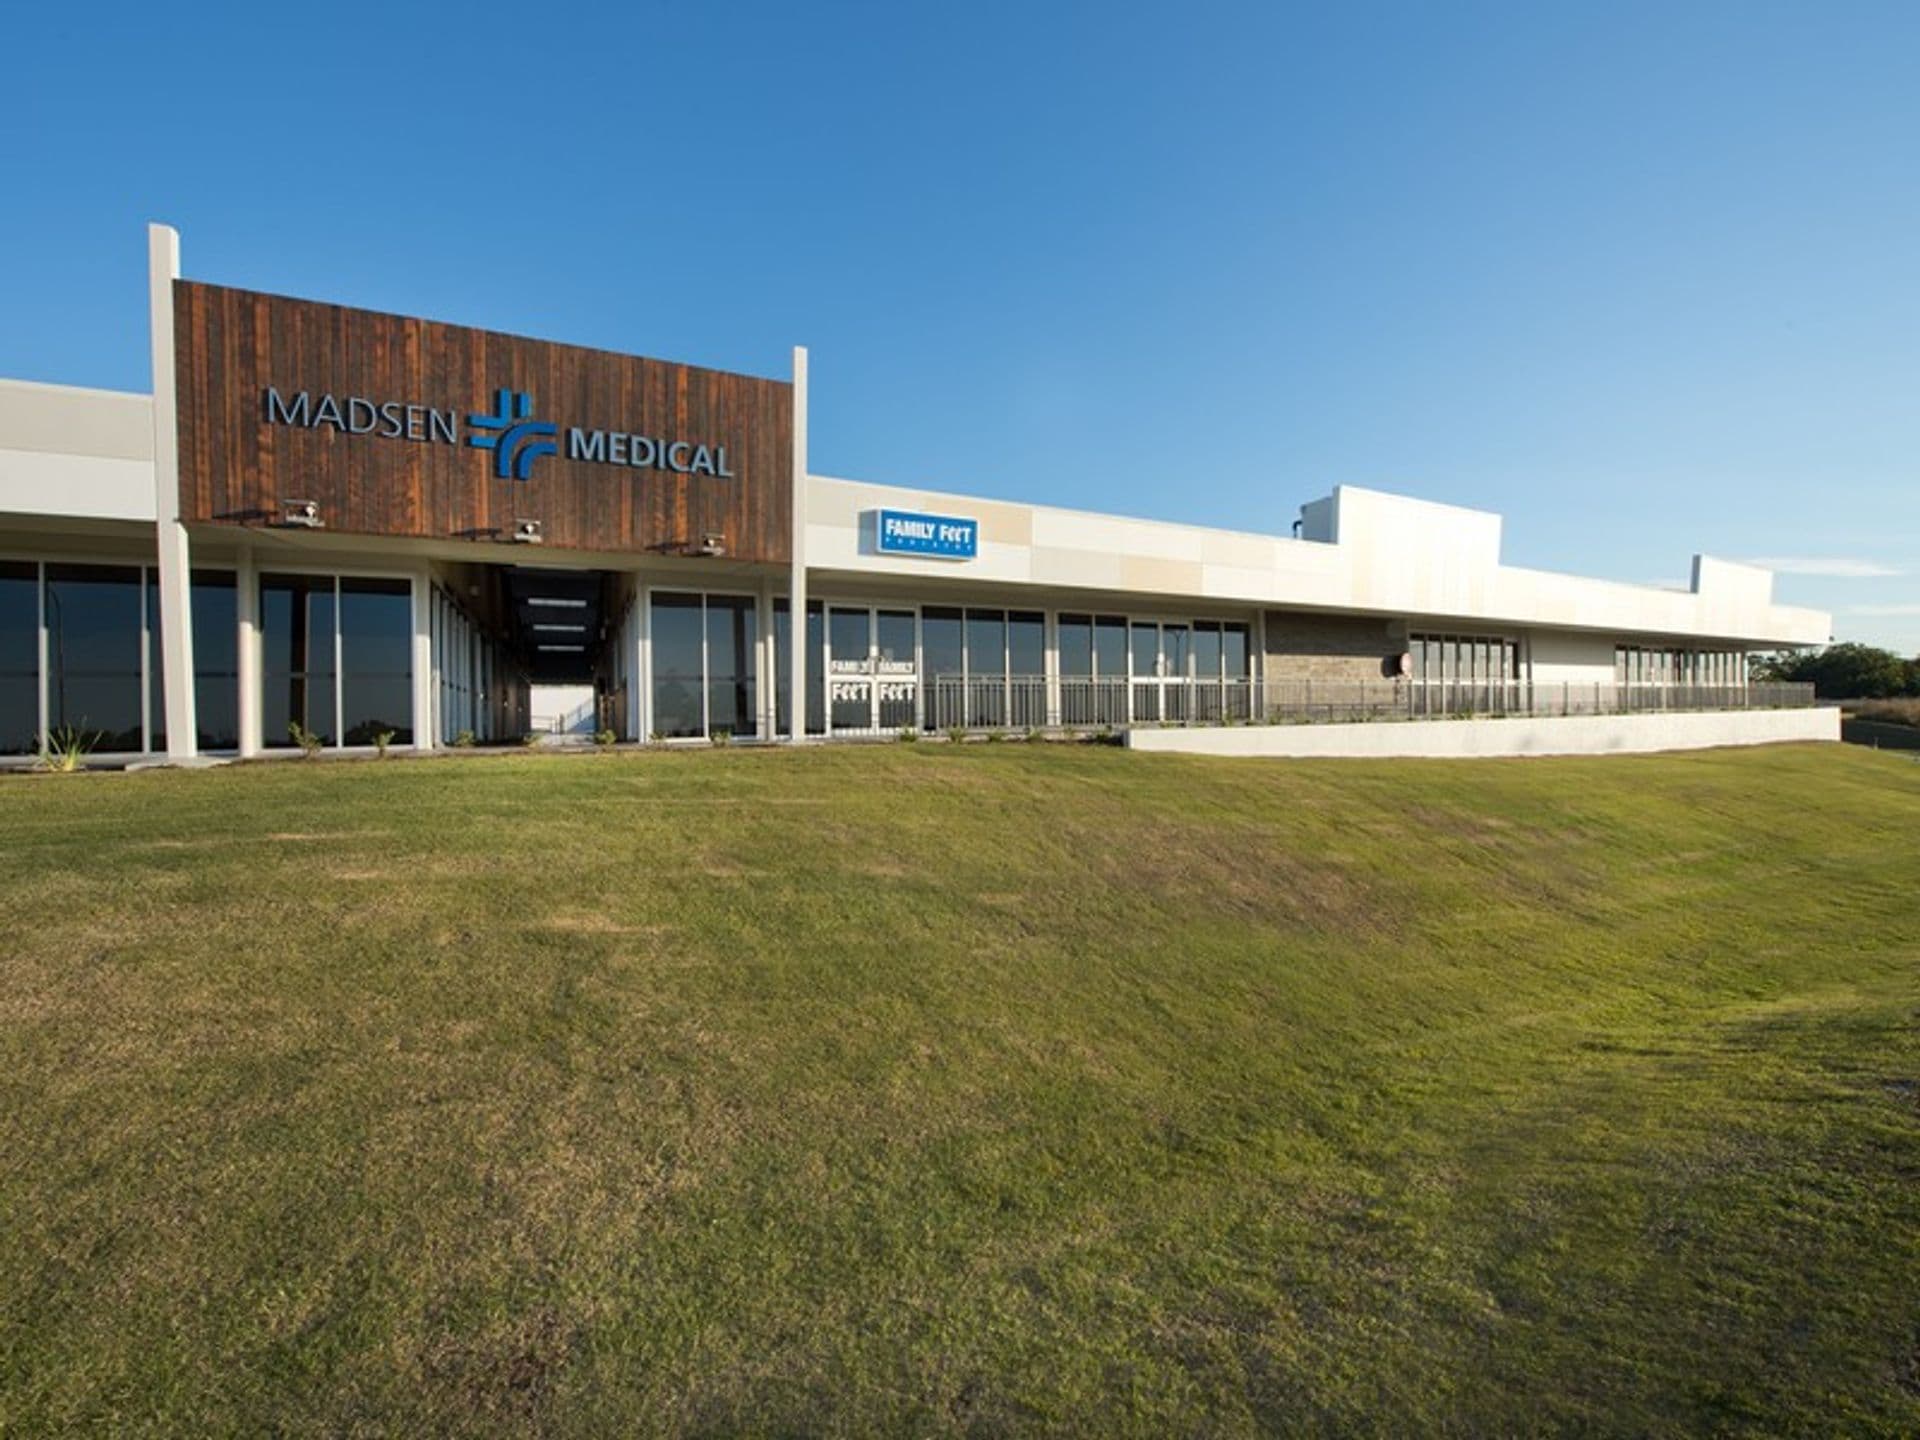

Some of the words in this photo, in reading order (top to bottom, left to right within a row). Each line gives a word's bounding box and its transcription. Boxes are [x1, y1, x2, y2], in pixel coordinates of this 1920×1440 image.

[266, 386, 457, 443] MADSEN
[568, 427, 735, 478] MEDICAL
[885, 518, 936, 540] FAMILY
